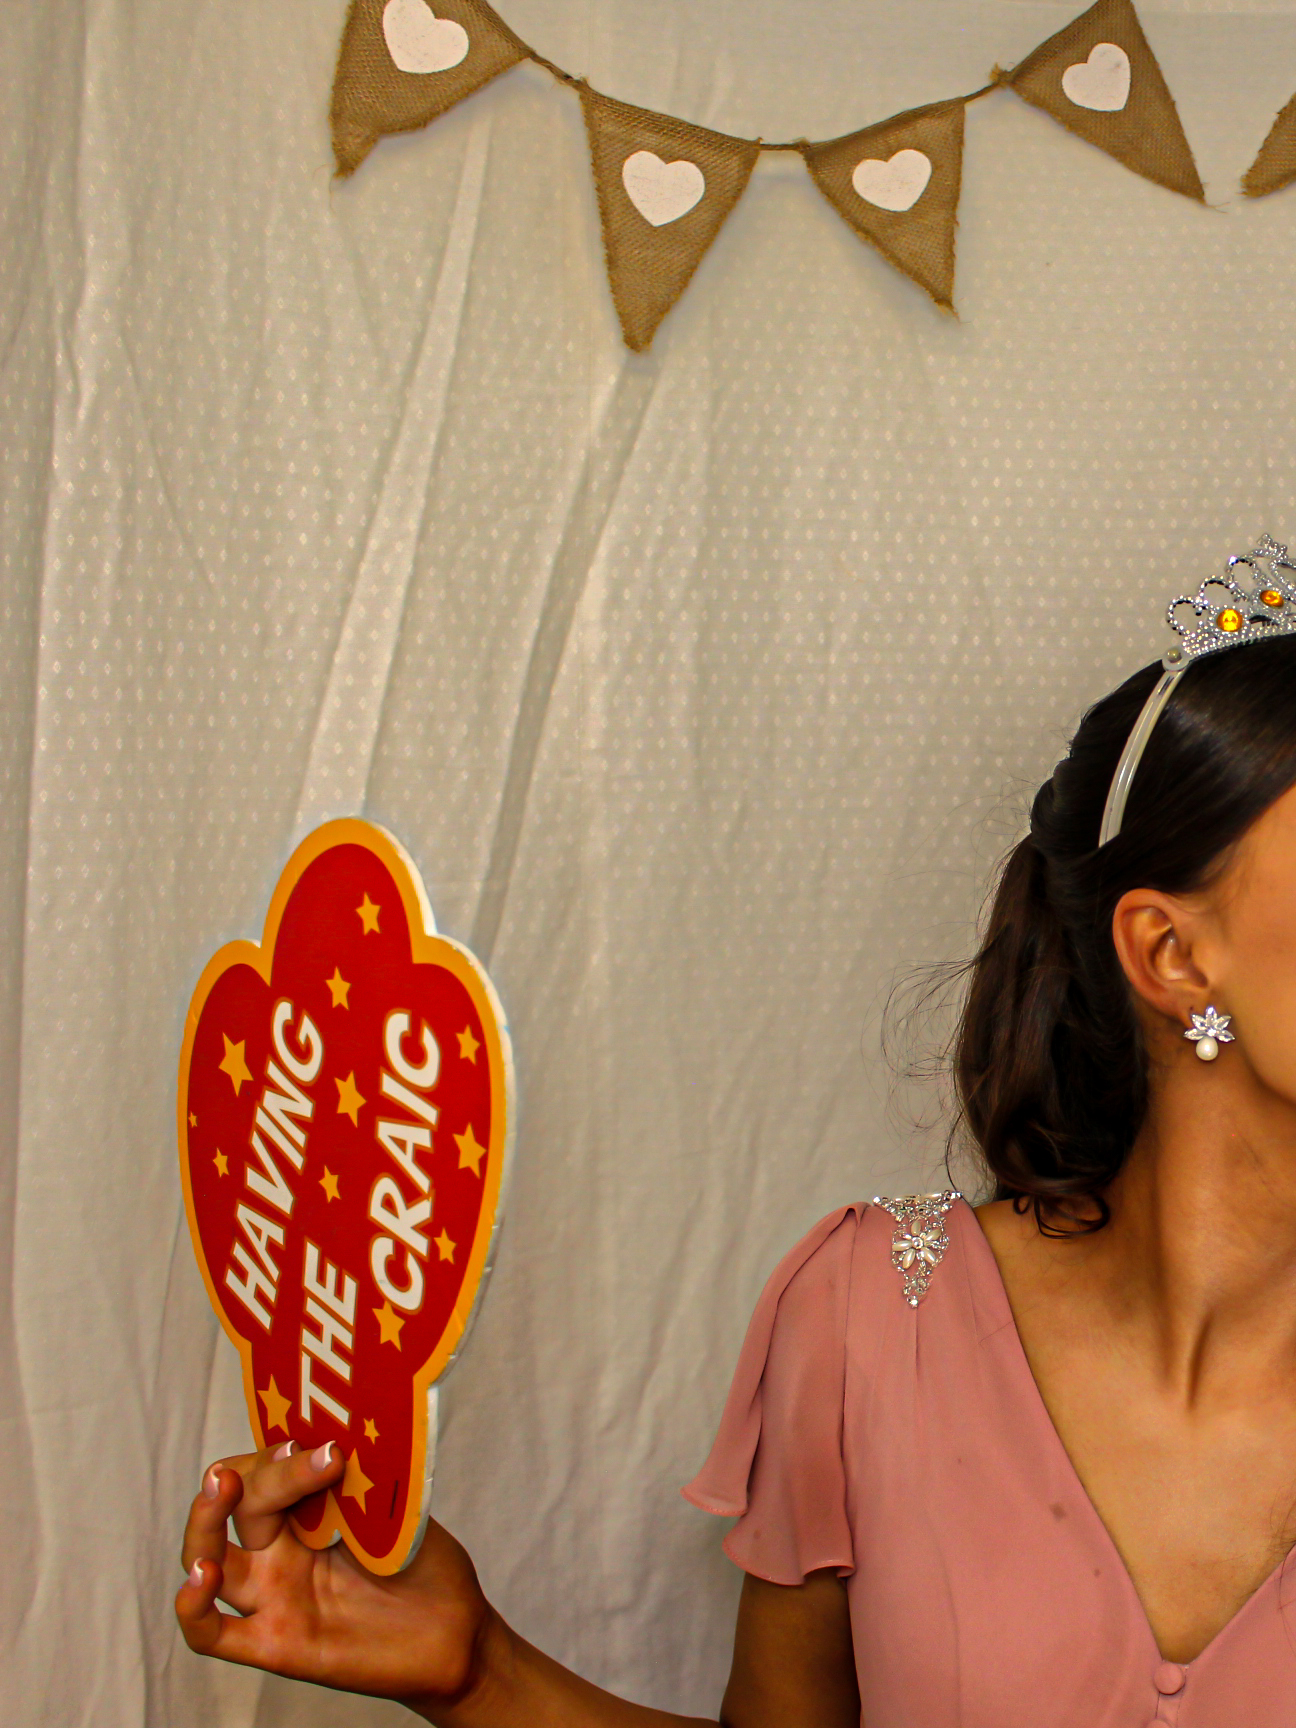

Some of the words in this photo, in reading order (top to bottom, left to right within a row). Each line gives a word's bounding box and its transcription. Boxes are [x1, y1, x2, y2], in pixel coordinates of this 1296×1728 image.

[224, 999, 323, 1330] HAVING
[370, 1011, 441, 1311] CRAIC
[301, 1241, 358, 1425] THE
